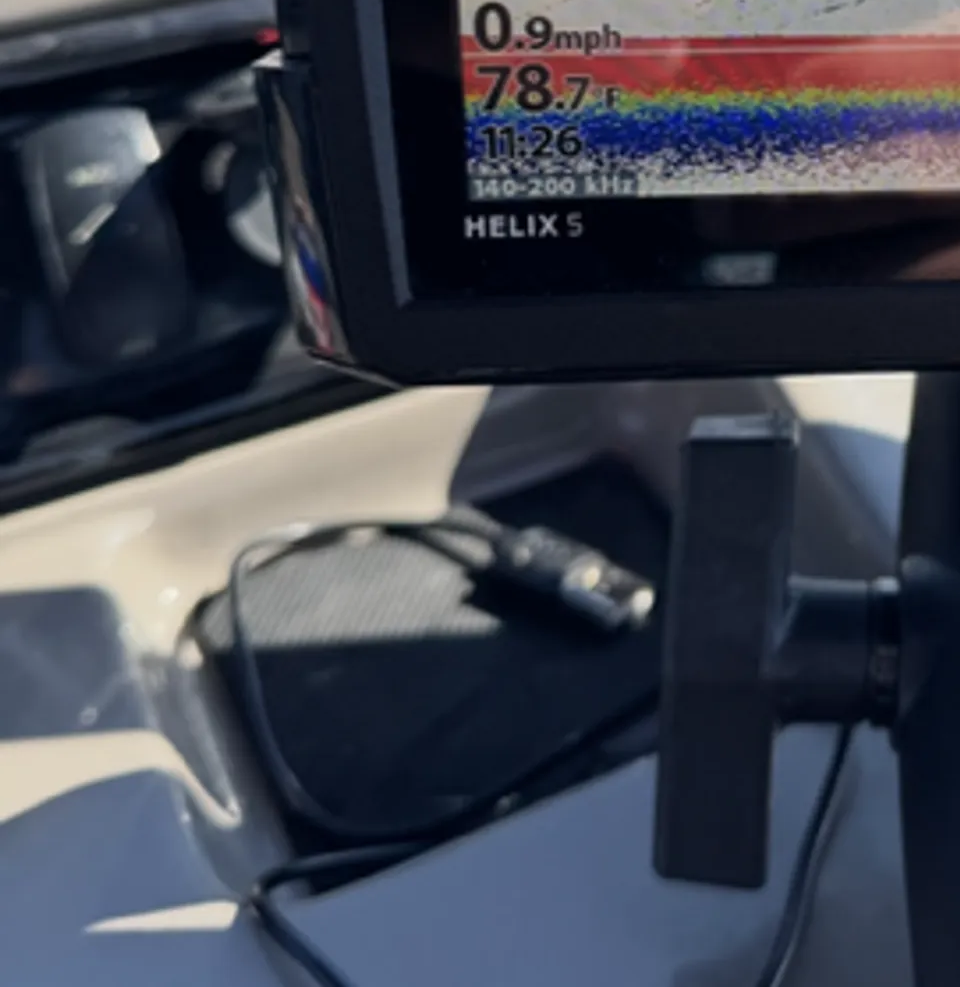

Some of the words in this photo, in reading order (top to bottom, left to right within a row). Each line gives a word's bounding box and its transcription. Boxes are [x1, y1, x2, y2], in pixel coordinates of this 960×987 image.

[474, 2, 621, 56] 0.9mph
[481, 126, 581, 160] 11:26
[472, 176, 577, 198] 140-200
[585, 172, 636, 196] kHz
[465, 214, 558, 238] HELIX
[566, 212, 583, 237] 5
